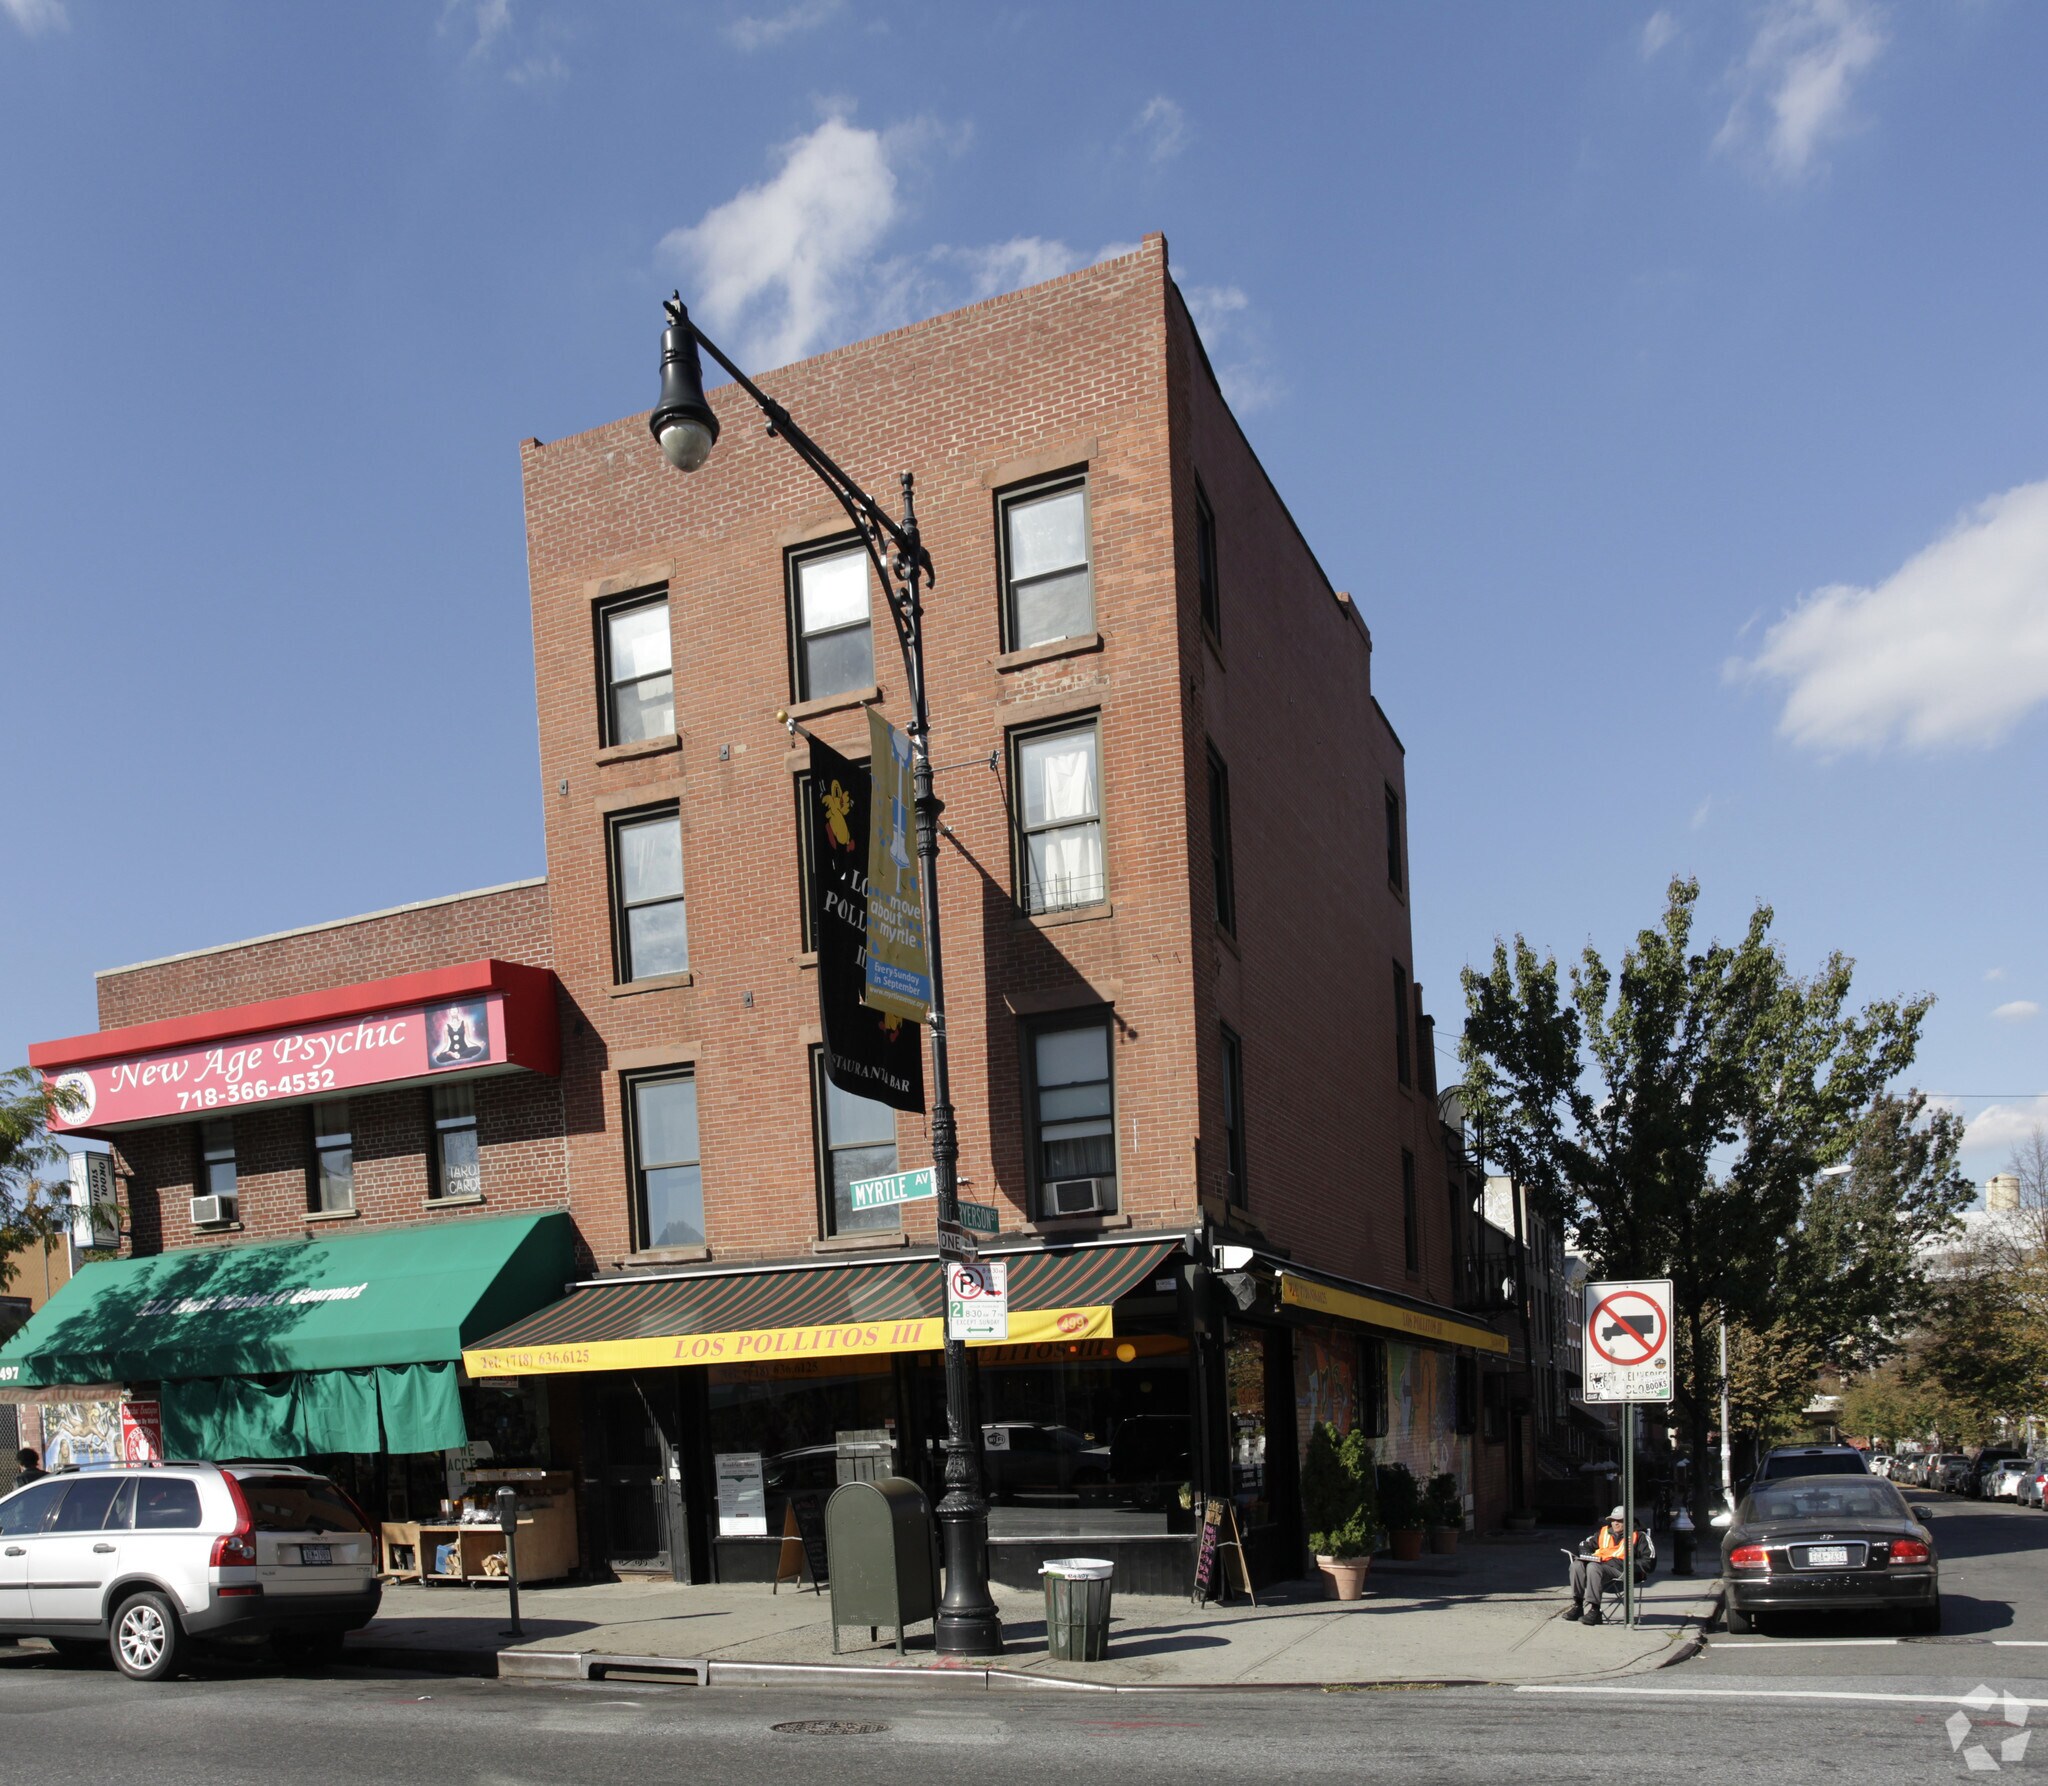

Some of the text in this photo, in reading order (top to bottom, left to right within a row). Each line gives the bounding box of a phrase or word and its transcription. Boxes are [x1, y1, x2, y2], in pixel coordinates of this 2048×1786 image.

[851, 869, 868, 898] LO
[824, 890, 867, 932] POLL
[870, 899, 903, 927] about
[890, 895, 920, 919] move
[880, 921, 917, 948] myrtle
[874, 961, 920, 985] Every Sunday
[874, 972, 920, 995] in September
[110, 1058, 188, 1092] New
[194, 1046, 262, 1083] Age
[273, 1016, 406, 1069] Psychic
[831, 1053, 885, 1081] STAURANT
[889, 1074, 910, 1092] BAR
[177, 1068, 335, 1110] 718-366-4532
[92, 1169, 100, 1202] SUSHI
[855, 1172, 929, 1206] MYRTLE AV
[959, 1203, 999, 1230] RYERSON ST
[941, 1233, 960, 1250] ONE
[290, 1282, 368, 1304] Gourmet
[952, 1302, 961, 1317] 2
[1062, 1315, 1085, 1330] 499
[673, 1323, 924, 1359] LOS POLLITOS III
[480, 1349, 590, 1369] Tel: (718) 636.6125
[0, 1366, 19, 1380] 497
[1645, 1380, 1667, 1391] BOOKS
